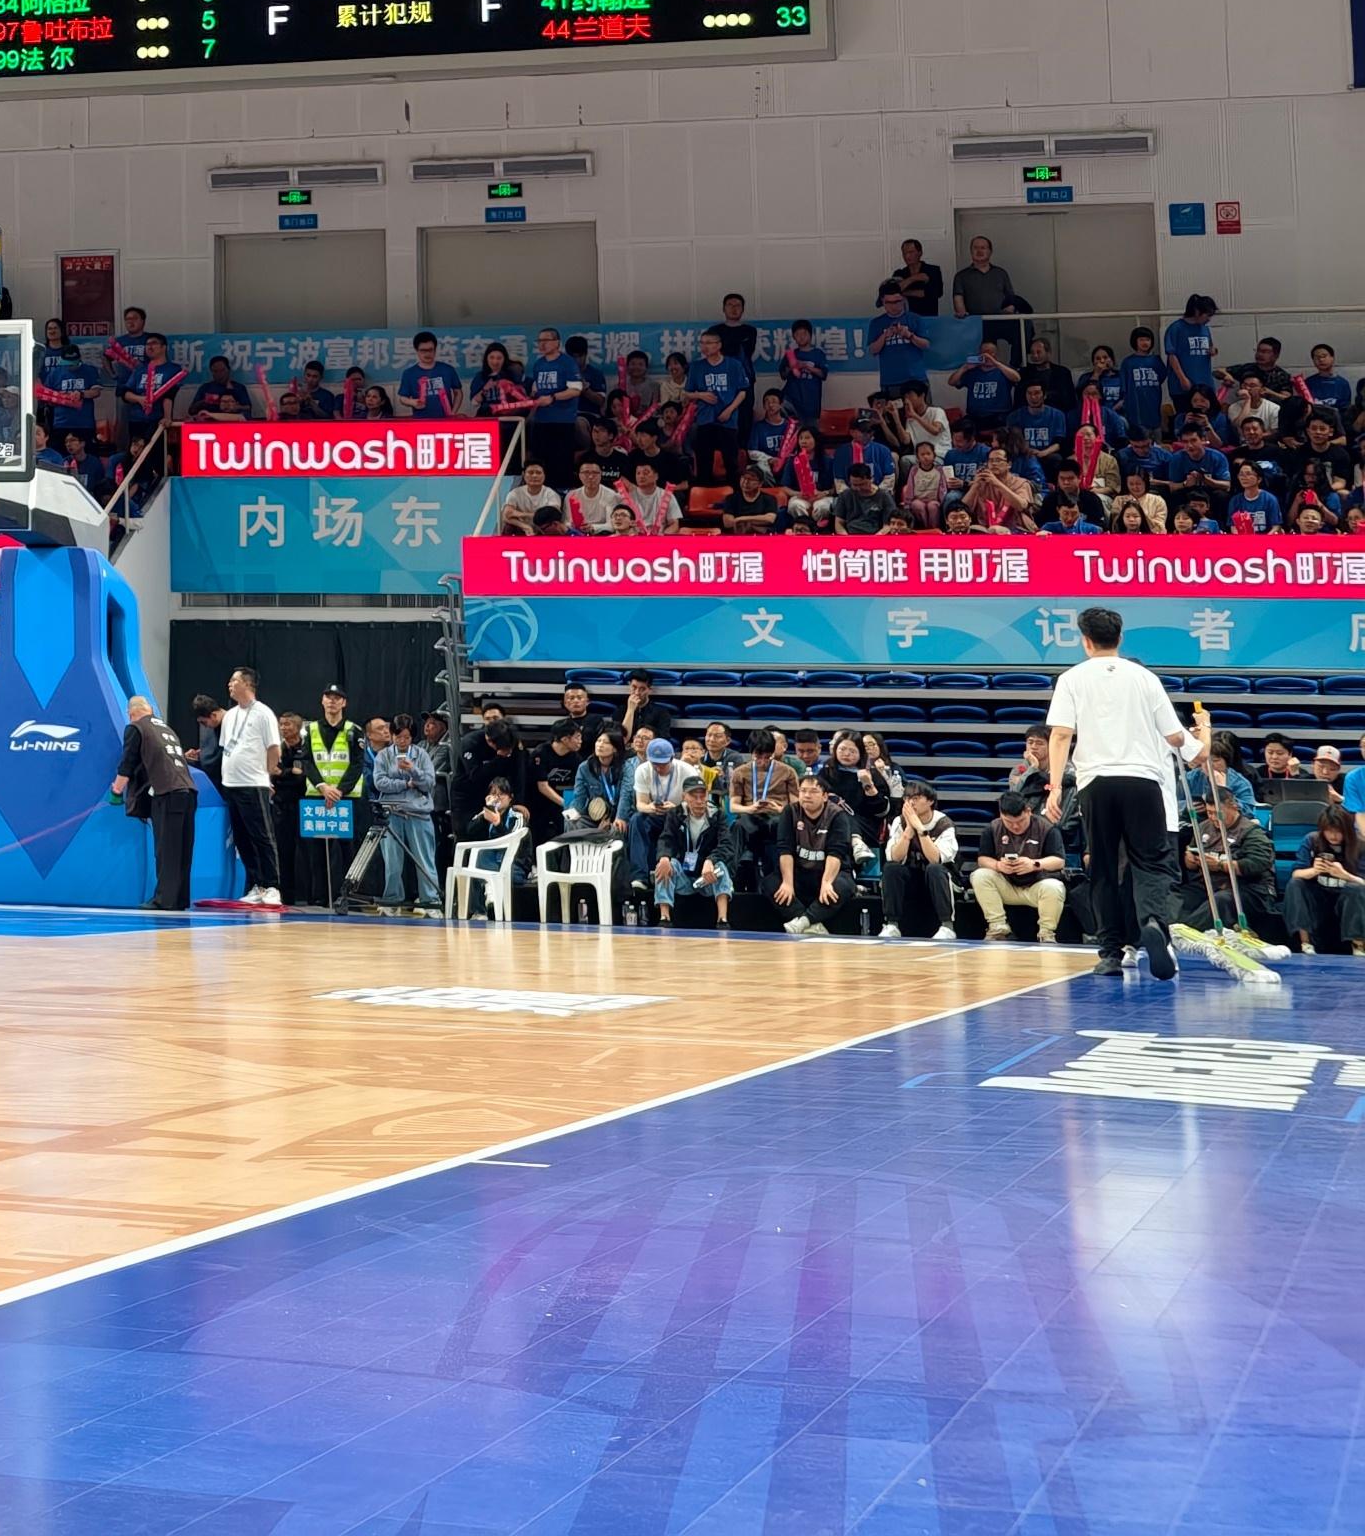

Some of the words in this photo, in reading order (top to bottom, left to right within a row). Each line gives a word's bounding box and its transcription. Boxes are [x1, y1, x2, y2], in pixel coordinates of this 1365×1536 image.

[22, 17, 113, 44] 鲁吐布拉
[201, 10, 215, 29] 5
[268, 4, 291, 36] F
[335, 1, 433, 28] 累计犯规
[542, 20, 570, 39] 44
[573, 14, 652, 41] 兰道夫
[776, 6, 806, 28] 33
[21, 46, 74, 71] 法尔
[201, 39, 215, 59] 7
[188, 430, 492, 471] Twinwash町渥
[237, 495, 443, 548] 内场东
[501, 550, 764, 584] Twinwash町渥
[802, 548, 908, 583] 怕筒脏
[918, 548, 1029, 584] 用町渥
[1074, 549, 1365, 584] Twinwash町渥
[9, 739, 81, 753] LI-NING
